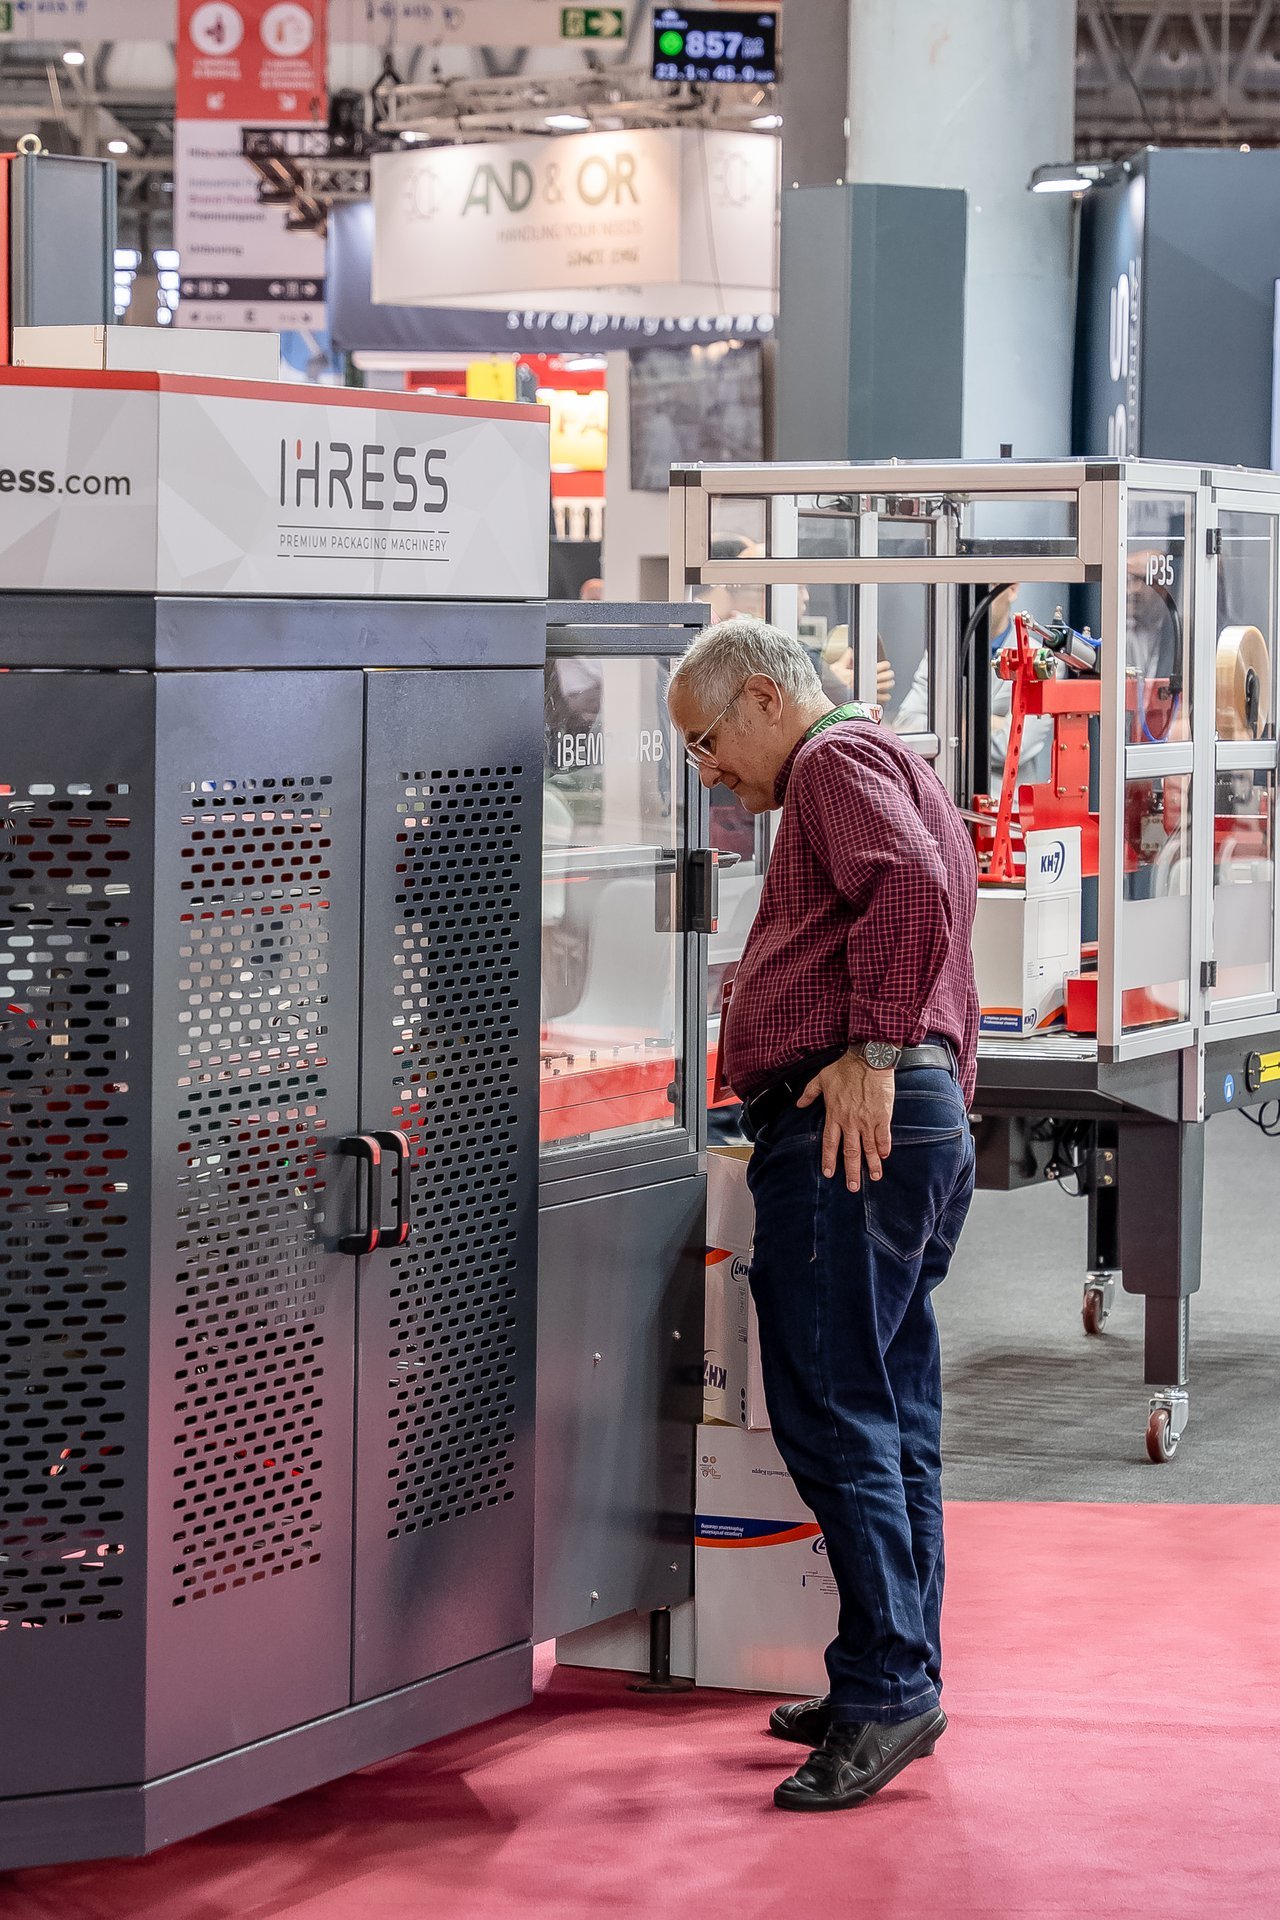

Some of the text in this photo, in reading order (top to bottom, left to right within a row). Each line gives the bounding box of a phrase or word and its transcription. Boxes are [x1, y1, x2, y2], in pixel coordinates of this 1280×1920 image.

[685, 30, 744, 59] 857
[461, 152, 641, 216] AND & OR
[0, 469, 131, 495] ess.com
[281, 438, 450, 513] IHRESS
[279, 534, 447, 552] PREMIUM PACKAGING MACHINERY
